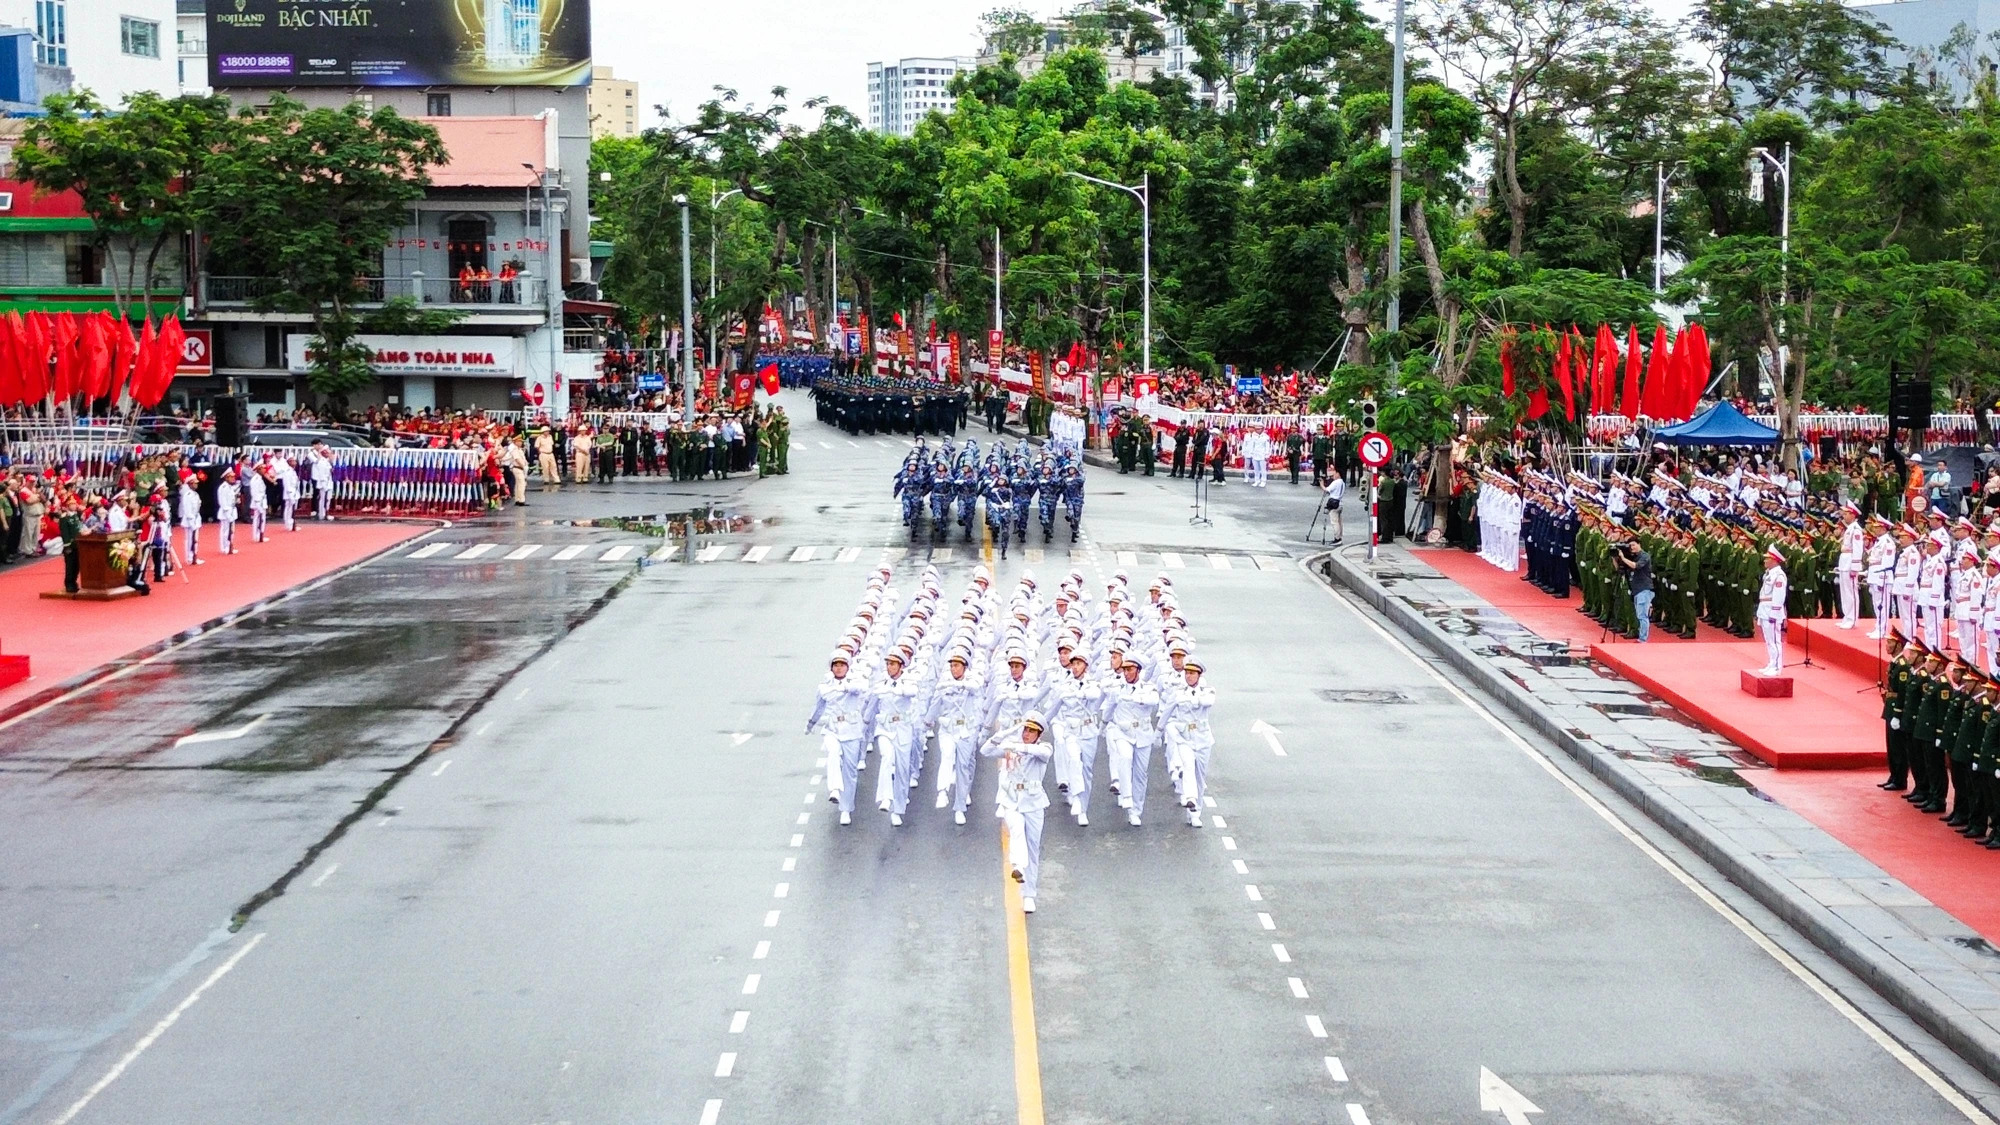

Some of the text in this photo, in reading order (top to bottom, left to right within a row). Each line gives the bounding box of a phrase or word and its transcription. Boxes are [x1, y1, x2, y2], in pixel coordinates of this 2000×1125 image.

[216, 14, 265, 24] DOJILAND
[278, 2, 372, 31] BẬC NHẤT
[188, 342, 202, 358] K
[461, 352, 495, 365] NHA
